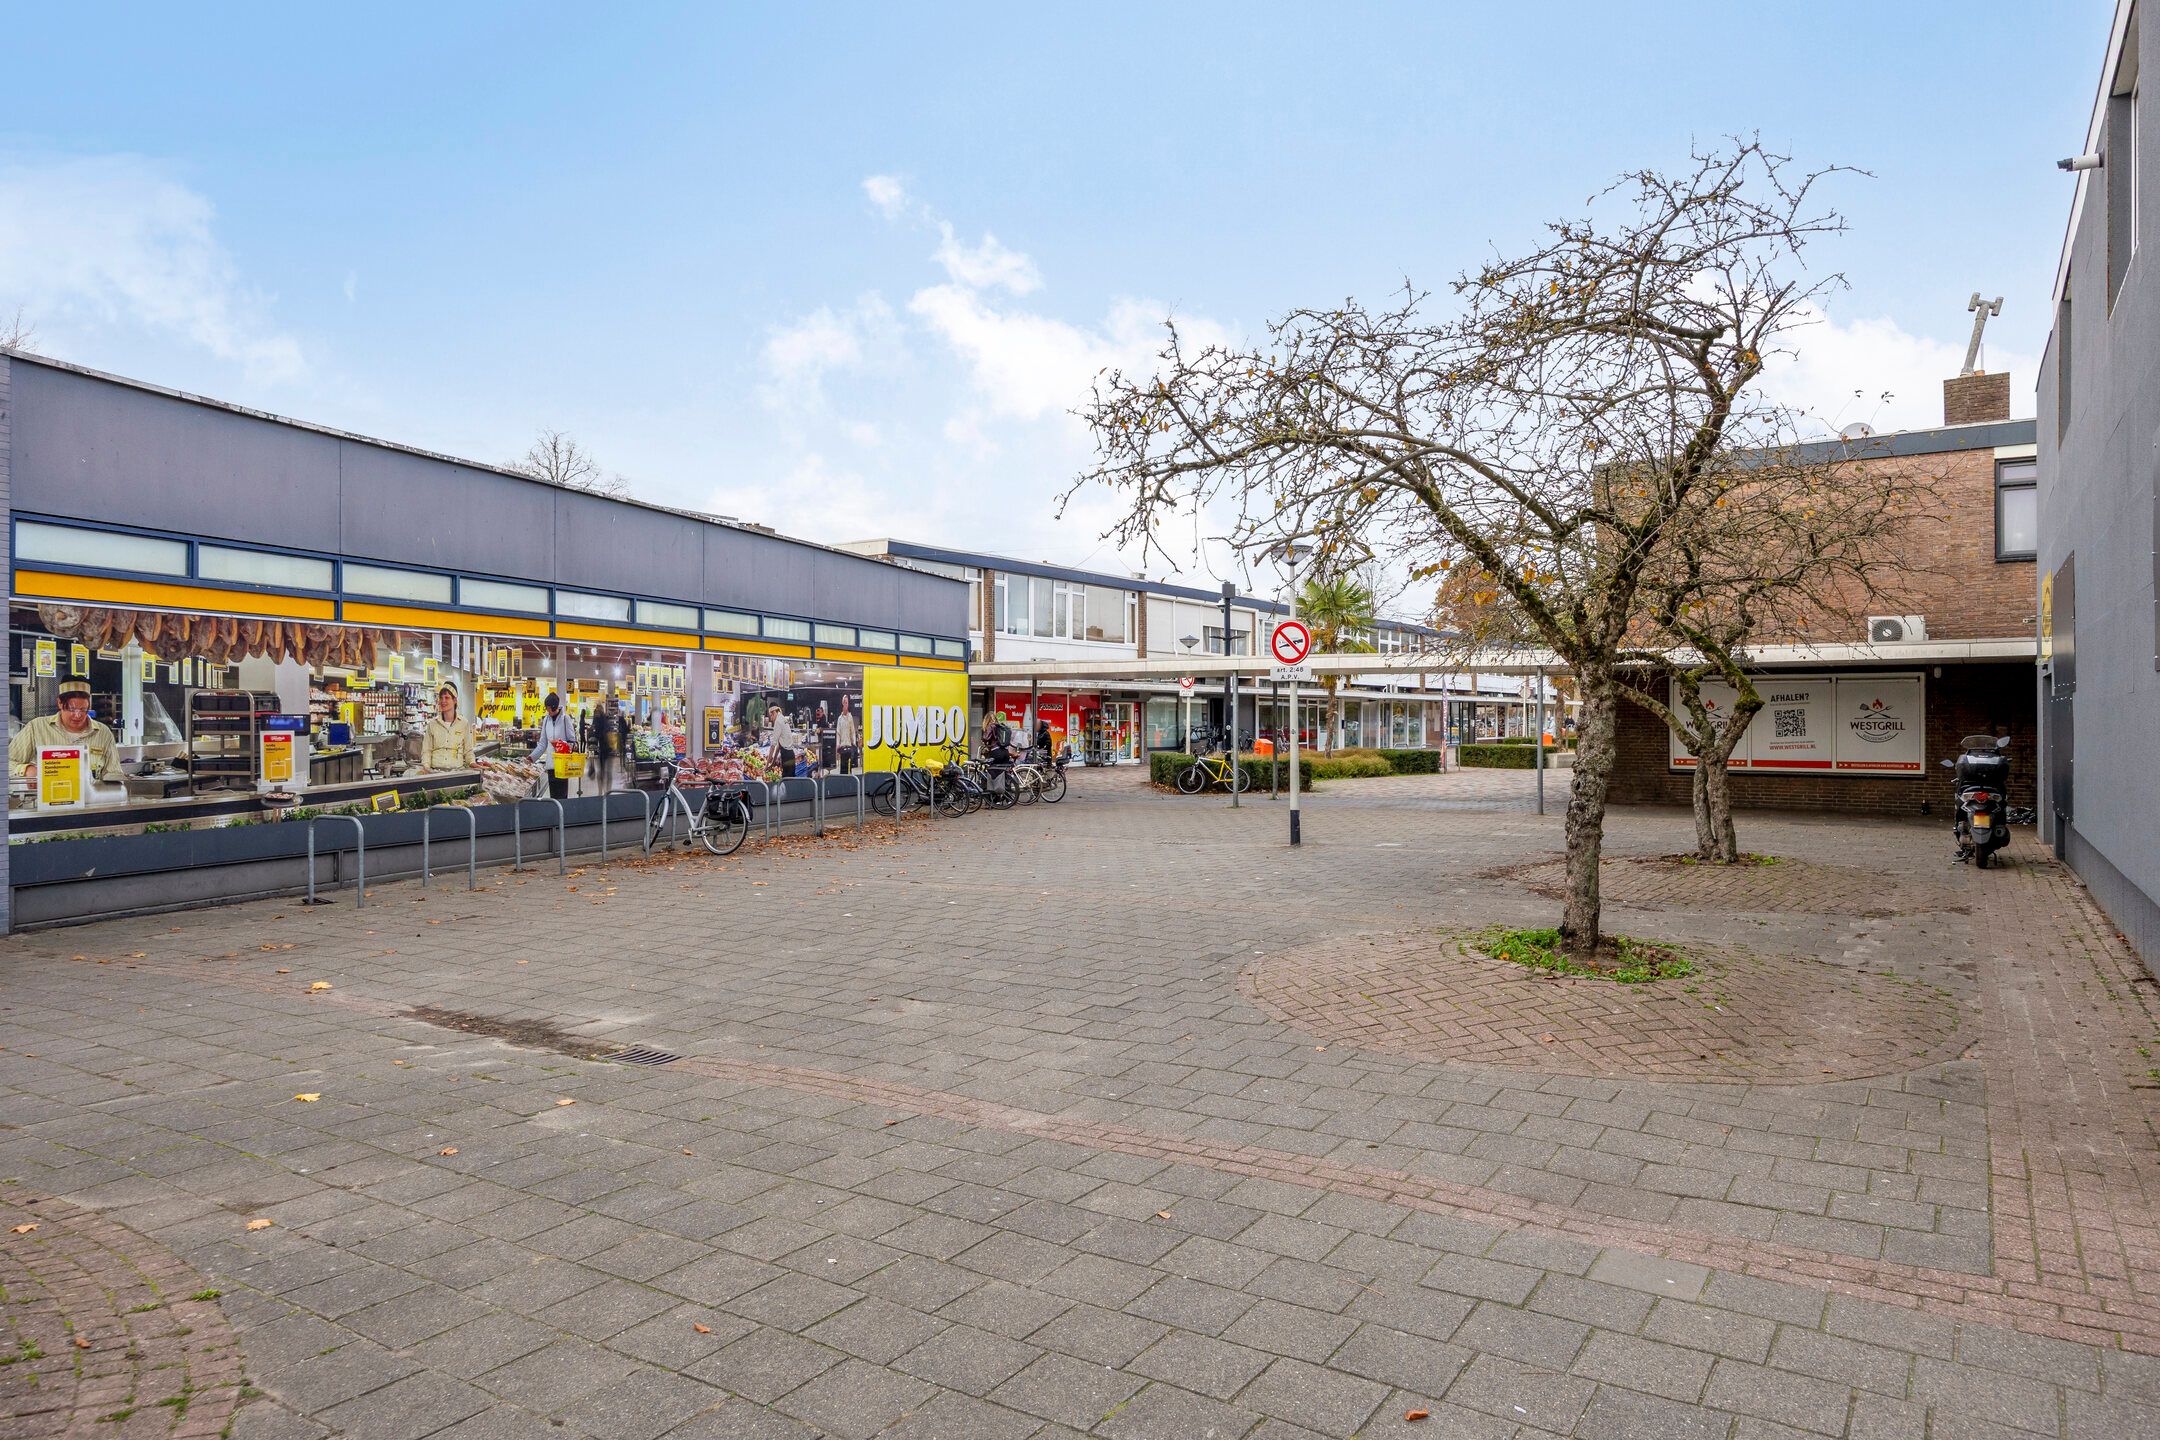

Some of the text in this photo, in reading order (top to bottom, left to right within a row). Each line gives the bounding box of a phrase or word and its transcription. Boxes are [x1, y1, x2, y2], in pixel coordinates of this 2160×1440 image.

[494, 689, 514, 698] dankt
[1770, 692, 1810, 702] AFHALEN?
[867, 705, 966, 749] JUMBO
[1849, 721, 1906, 731] WESTGRILL
